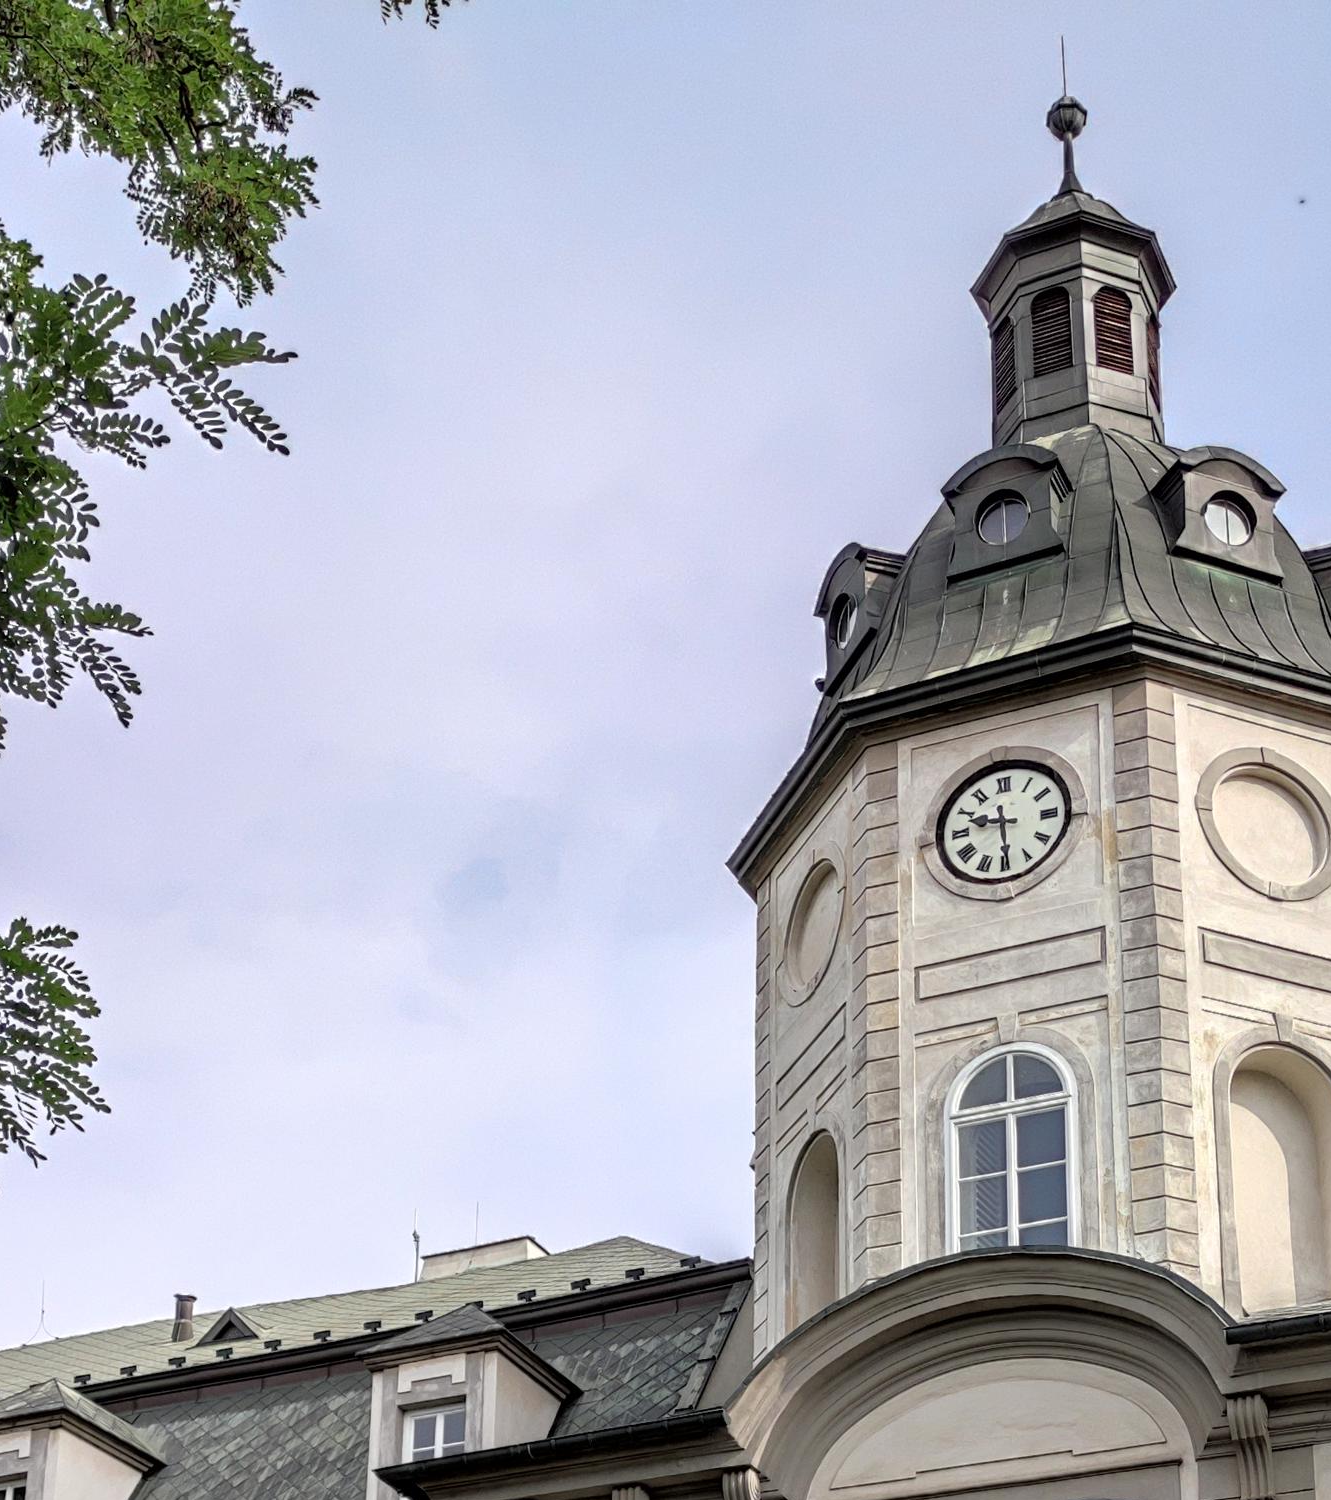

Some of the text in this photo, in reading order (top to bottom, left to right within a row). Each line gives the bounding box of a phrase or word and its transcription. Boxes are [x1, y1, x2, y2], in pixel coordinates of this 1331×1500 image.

[996, 776, 1012, 794] XII
[1022, 777, 1033, 793] I
[971, 788, 990, 806] XI
[1033, 786, 1051, 802] II
[957, 808, 975, 818] X
[1040, 807, 1058, 821] III
[952, 828, 969, 840] IX
[956, 843, 977, 864] VIII
[1021, 848, 1033, 863] V
[976, 854, 993, 872] VII
